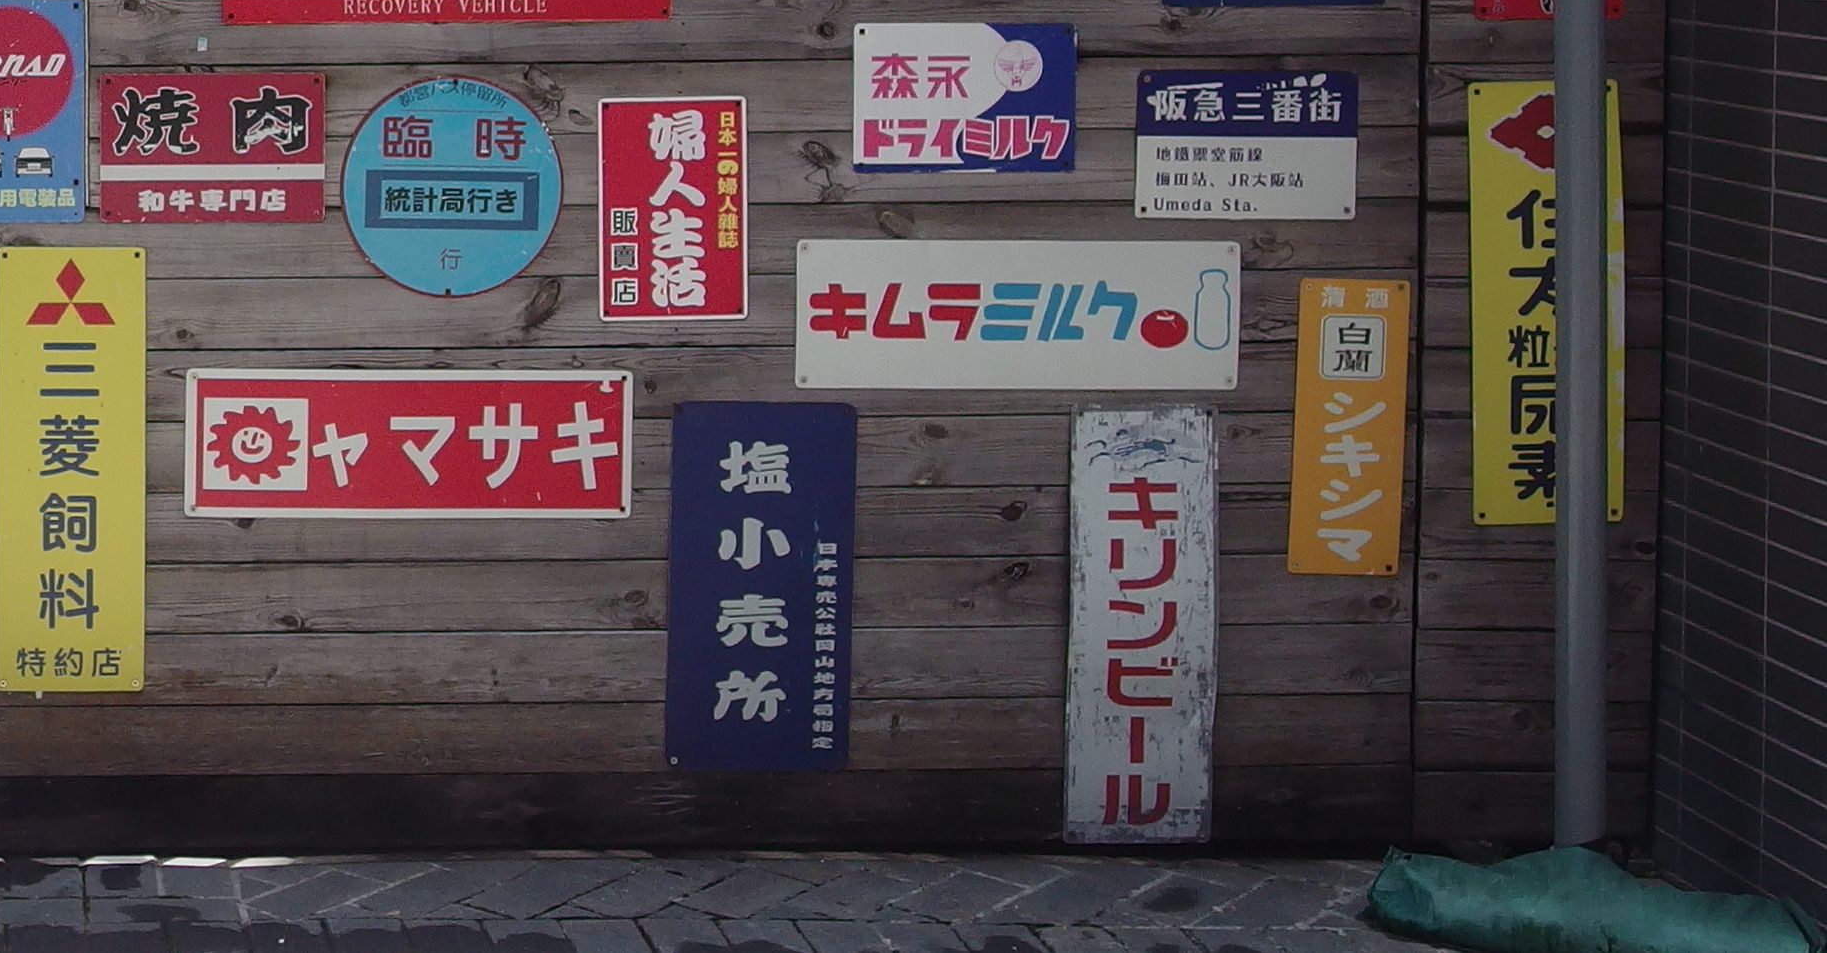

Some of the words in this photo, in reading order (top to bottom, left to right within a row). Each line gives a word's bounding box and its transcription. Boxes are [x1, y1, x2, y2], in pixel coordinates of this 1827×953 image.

[871, 52, 971, 99] 森永
[112, 84, 314, 157] 焼肉
[1154, 87, 1343, 123] 阪急三番街
[382, 115, 528, 160] 臨時
[862, 116, 1071, 162] ドライミルク
[137, 188, 287, 213] 和牛専門店
[384, 186, 519, 215] 統計局行き
[648, 109, 706, 308] 婦人生活
[1153, 197, 1213, 212] Umeda
[1222, 197, 1258, 212] Sta.
[440, 249, 462, 271] 行
[808, 279, 1138, 342] キムラミルク
[38, 341, 100, 631] 三菱飼料
[1317, 391, 1387, 562] シキシマ
[713, 440, 792, 723] 塩小売所
[15, 647, 122, 679] 特約店
[1102, 477, 1178, 826] キリンビール
